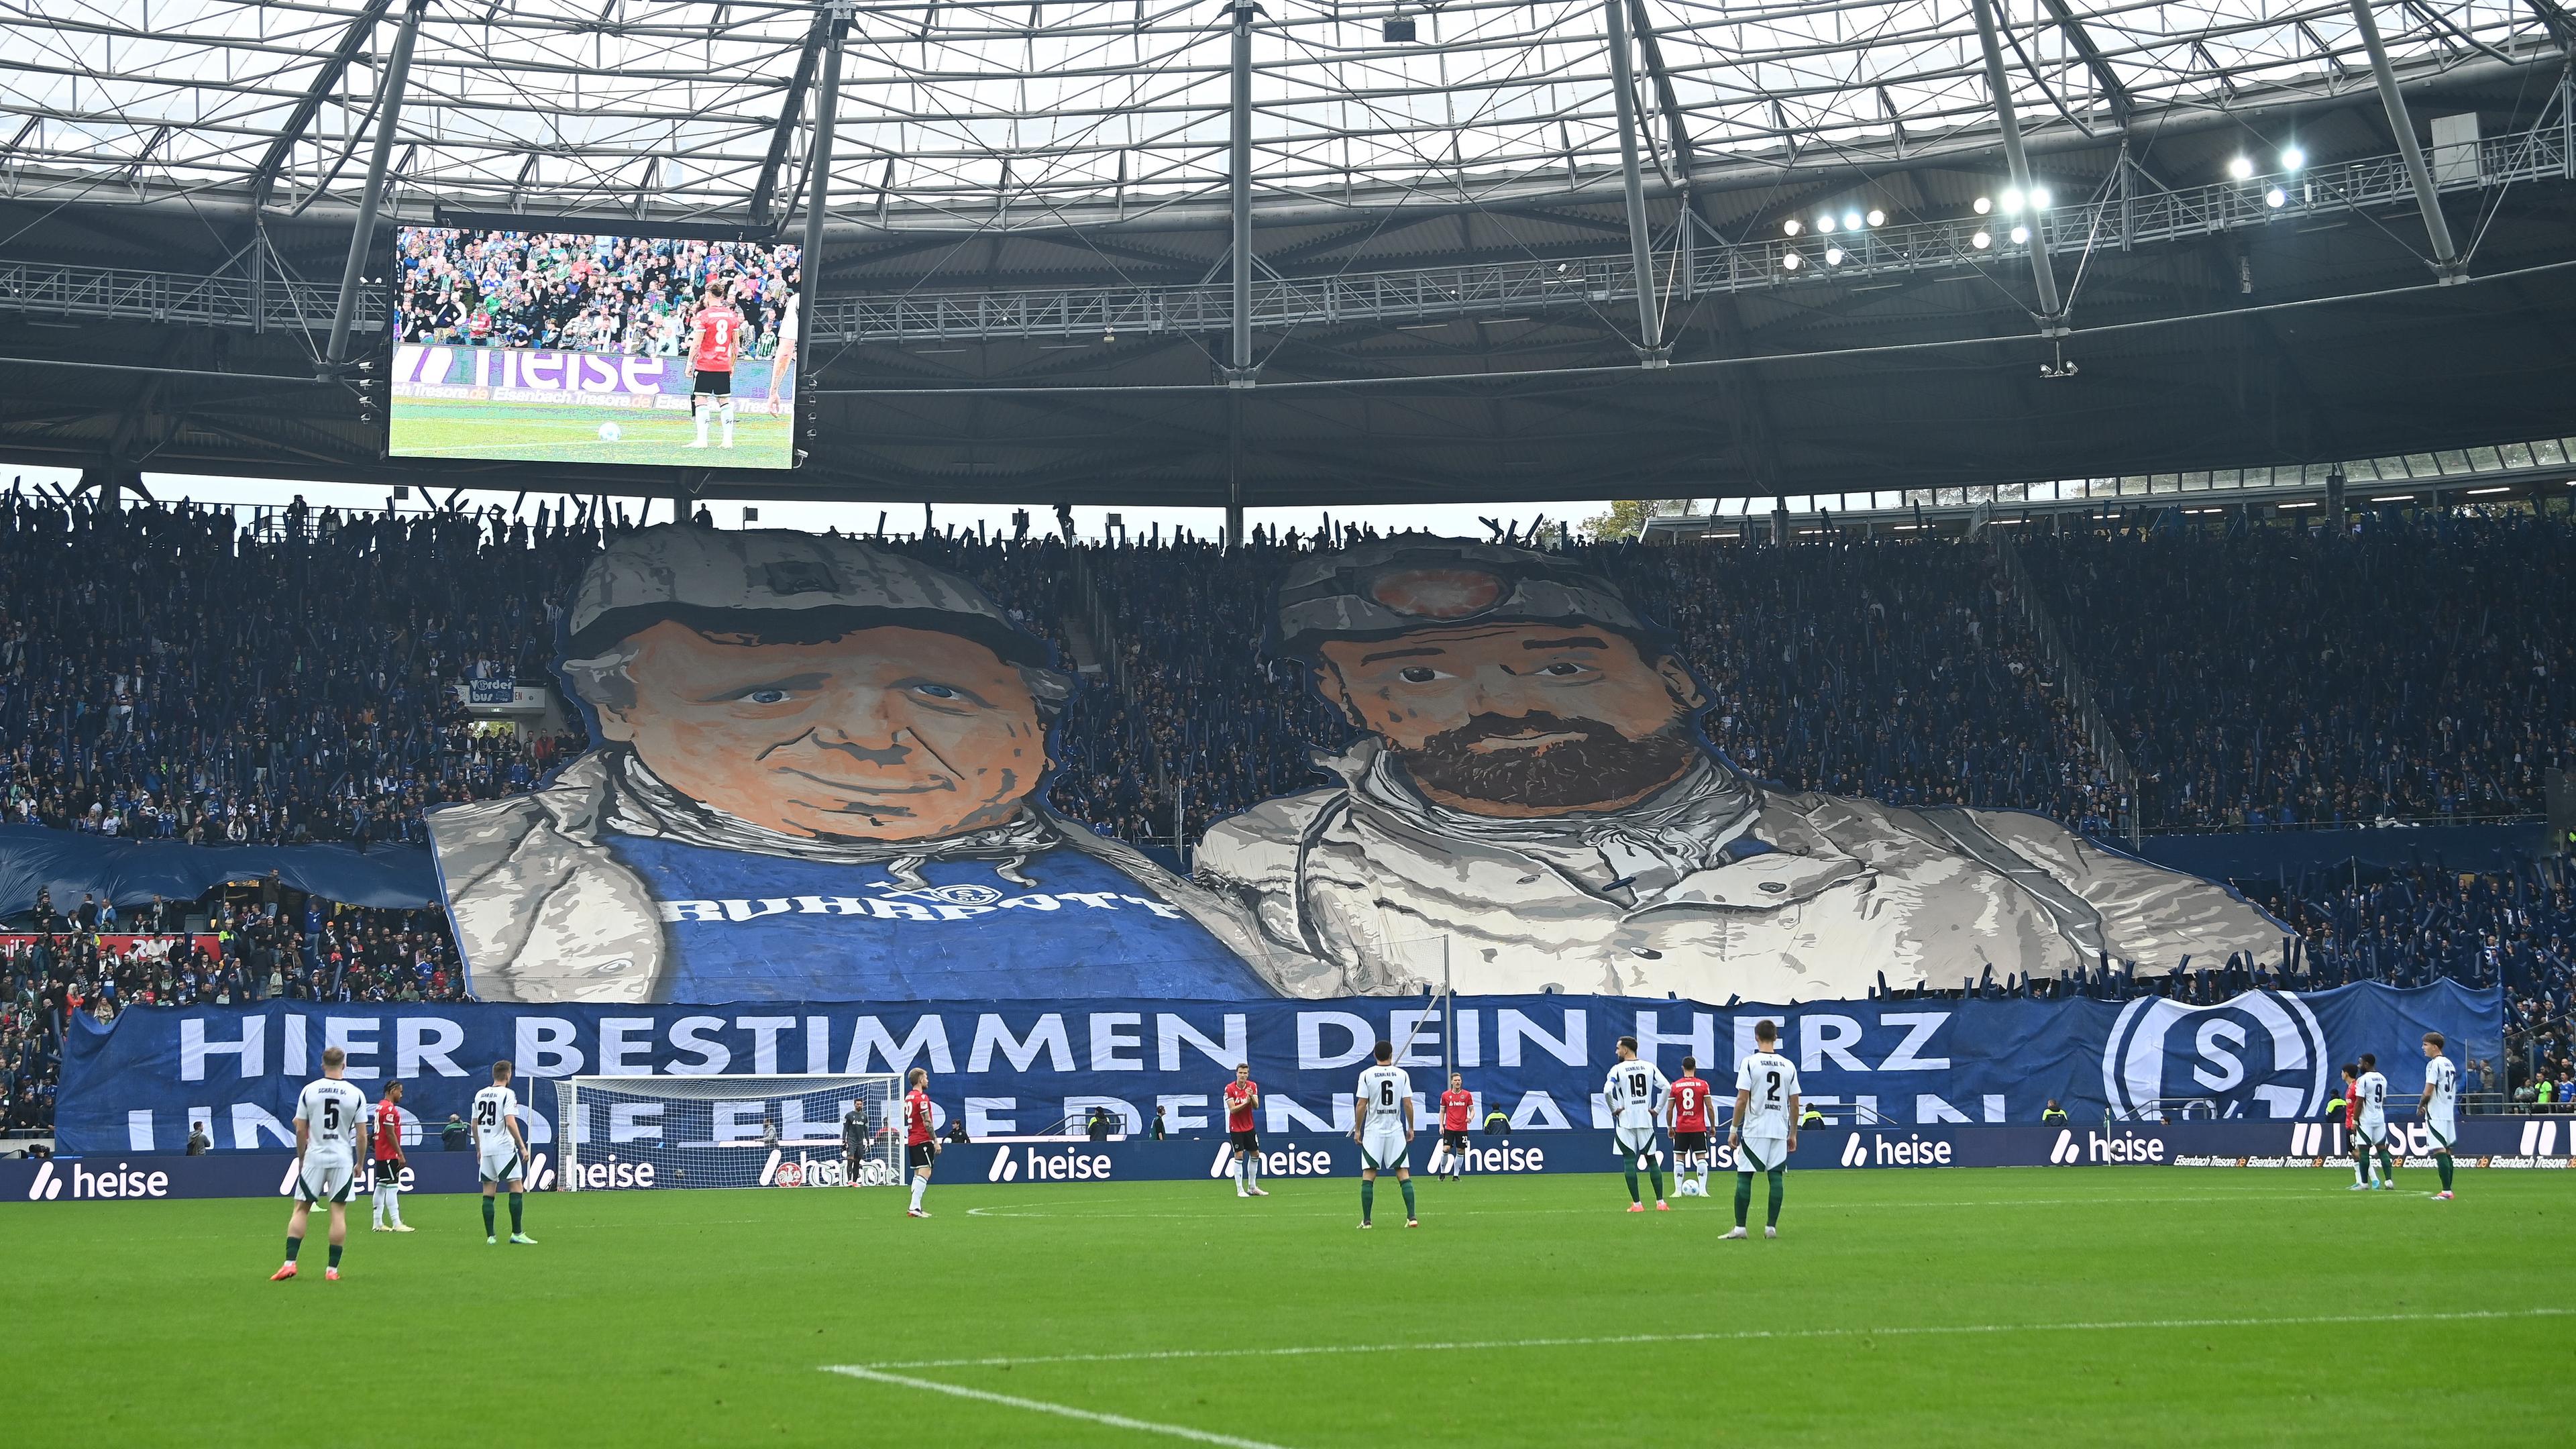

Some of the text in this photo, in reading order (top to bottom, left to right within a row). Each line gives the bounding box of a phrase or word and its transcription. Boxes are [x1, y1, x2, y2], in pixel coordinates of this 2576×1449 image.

[715, 319, 728, 345] 8
[472, 691, 493, 702] bus
[660, 892, 1186, 922] RUHRPOTT
[180, 1009, 1951, 1081] HIER BESTIMMEN DEIN HERZ
[1381, 1080, 1393, 1106] 6
[1628, 1073, 1647, 1097] 19
[1682, 1088, 1695, 1110] 8
[1767, 1071, 1780, 1102] 2
[2375, 1083, 2382, 1103] 9
[324, 1098, 340, 1130] 5
[478, 1100, 496, 1126] 29
[1464, 1139, 1544, 1172] heise
[1876, 1134, 1951, 1167] heise
[2089, 1131, 2164, 1162] heise
[2174, 1155, 2210, 1166] Eisenbach
[2210, 1155, 2247, 1167] Tresore.de
[2247, 1155, 2282, 1167] Eisenbach
[2284, 1155, 2324, 1168] Tresore.de
[2323, 1156, 2354, 1168] Eisenba
[2489, 1155, 2534, 1168] Eisenbach
[566, 1154, 655, 1188] heise
[1028, 1147, 1112, 1180] heise
[73, 1163, 168, 1198] heise
